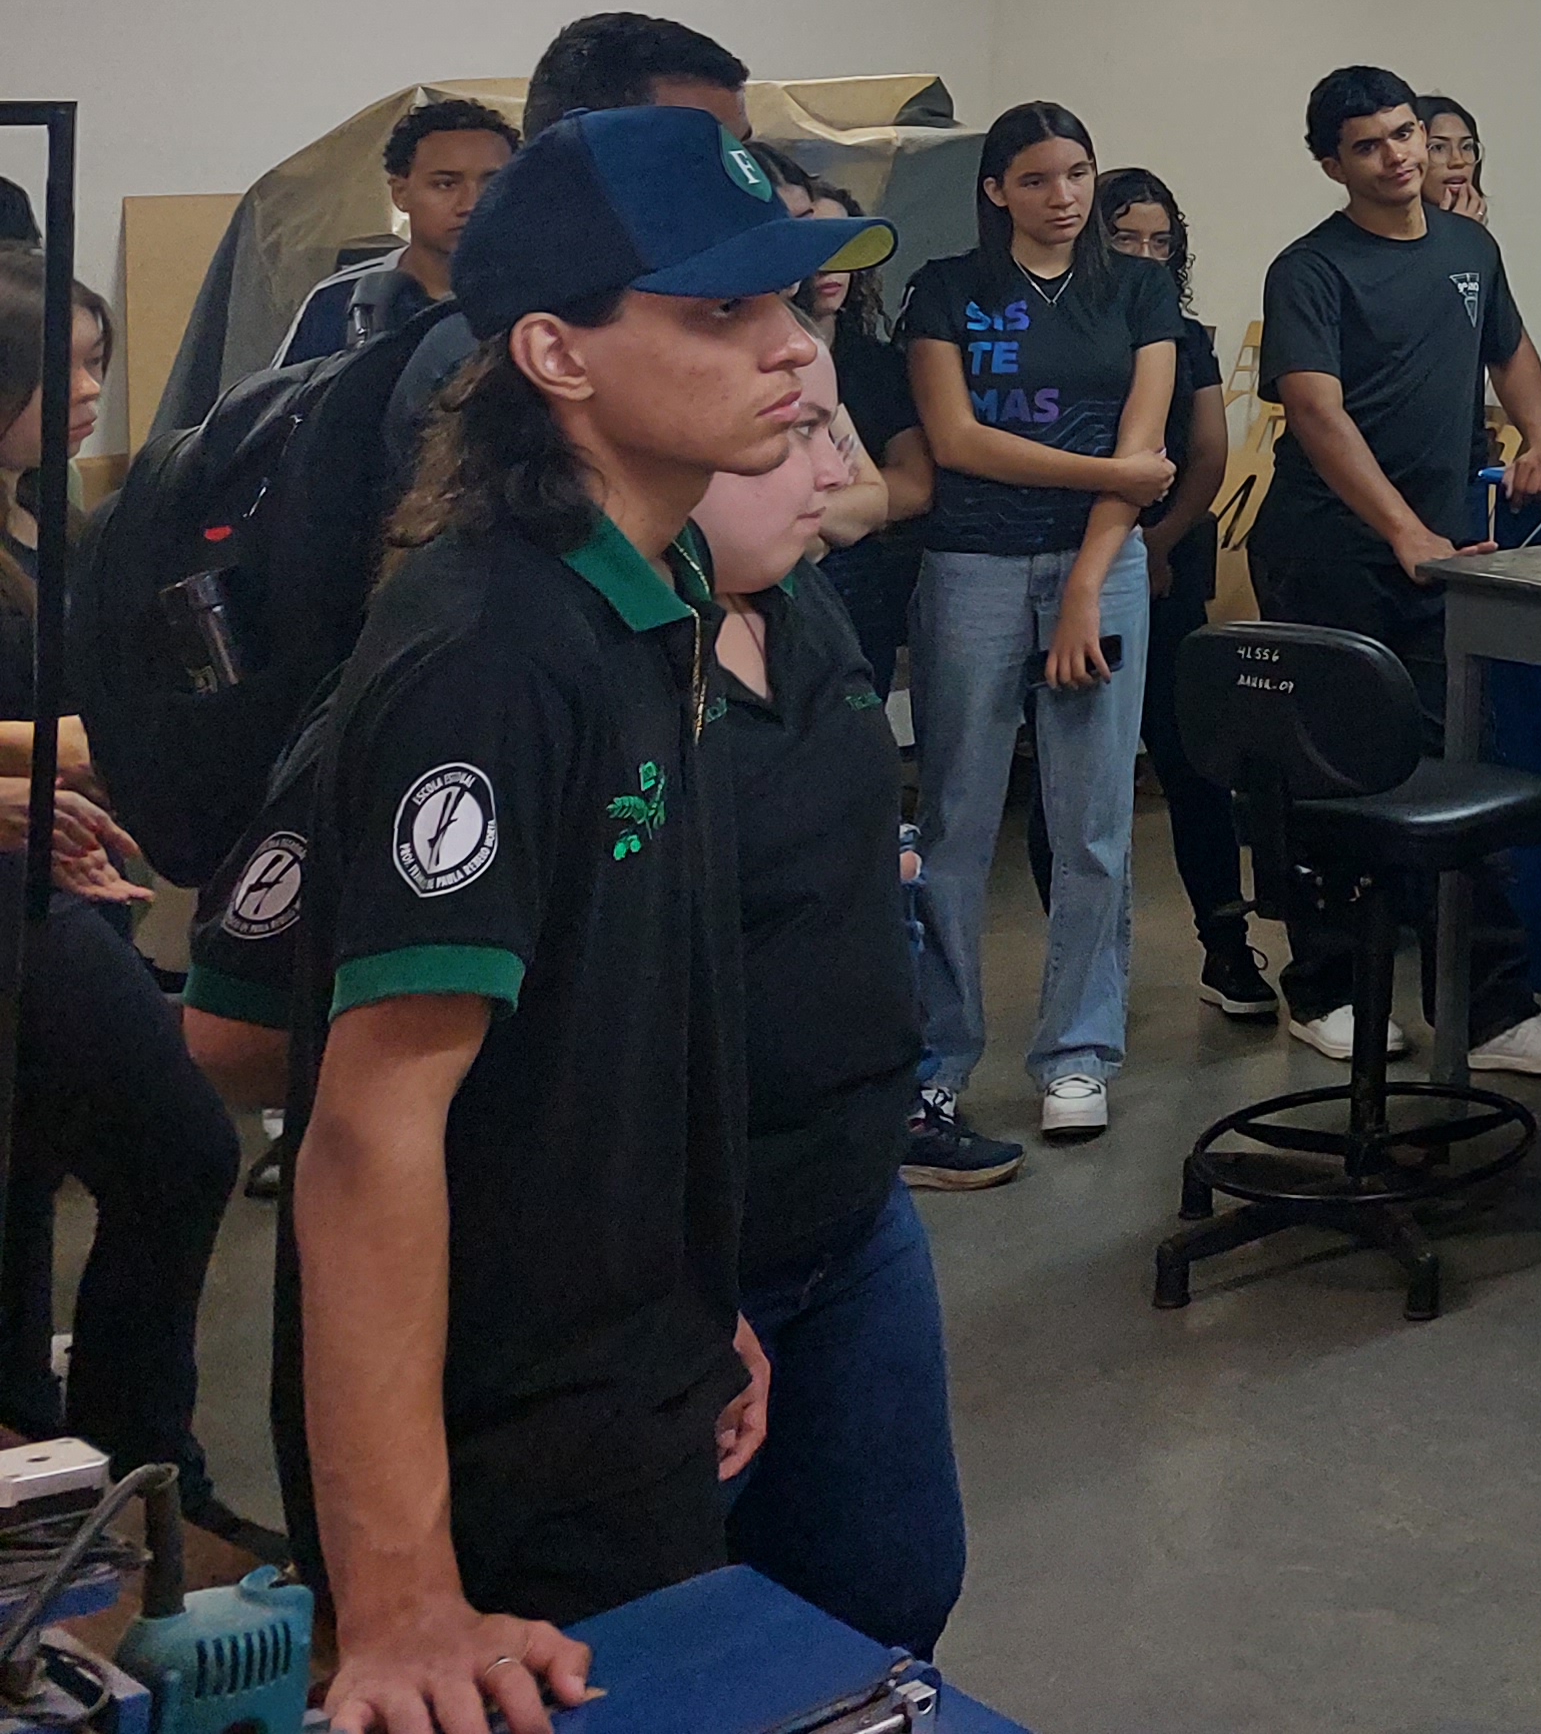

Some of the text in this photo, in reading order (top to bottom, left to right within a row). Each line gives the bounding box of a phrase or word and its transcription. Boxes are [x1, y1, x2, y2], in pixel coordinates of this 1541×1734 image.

[728, 150, 761, 184] F
[966, 300, 1030, 331] SIS
[968, 341, 1020, 375] TE
[970, 388, 1060, 422] MAS
[1236, 646, 1280, 663] 41556
[412, 777, 443, 806] ESCOLA
